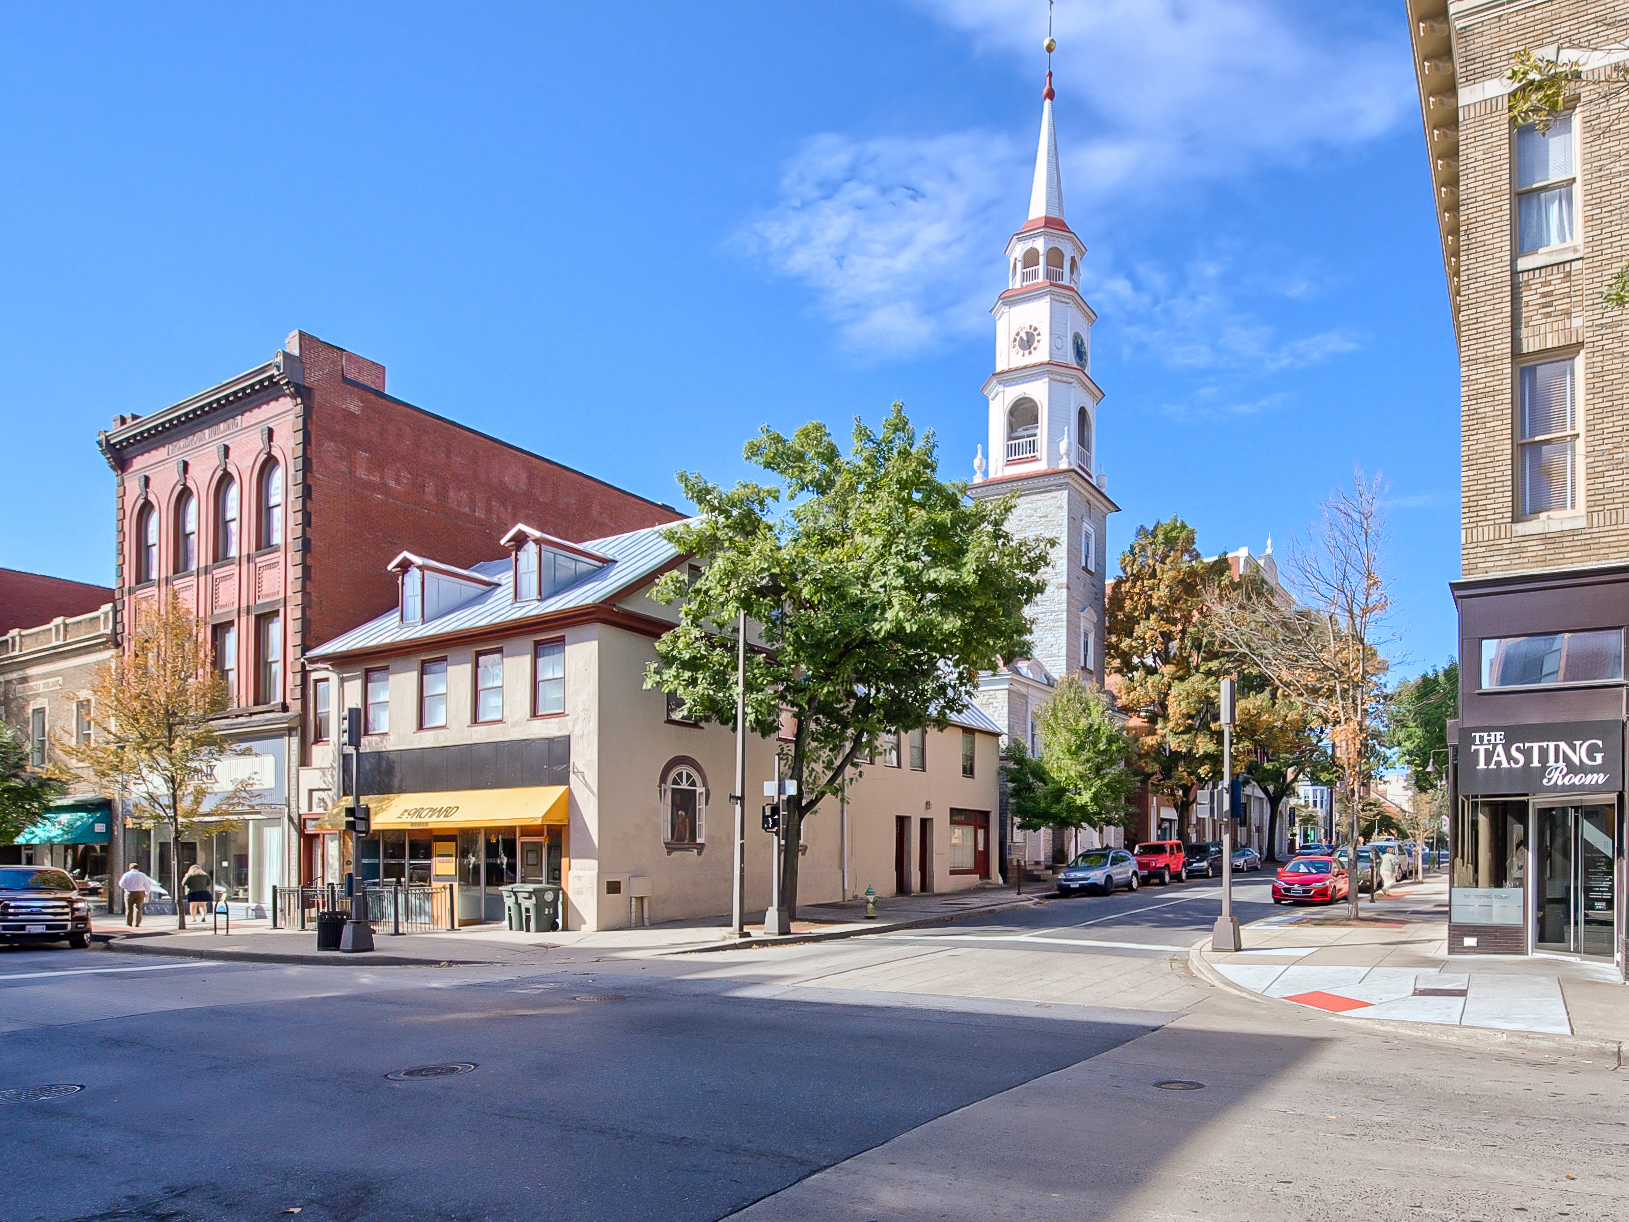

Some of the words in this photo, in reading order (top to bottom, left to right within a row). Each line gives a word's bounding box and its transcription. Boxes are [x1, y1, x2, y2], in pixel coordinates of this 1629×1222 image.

[1471, 731, 1506, 745] THE
[1471, 739, 1605, 769] TASTING
[1542, 763, 1610, 787] Room
[407, 805, 460, 819] ORCHARD
